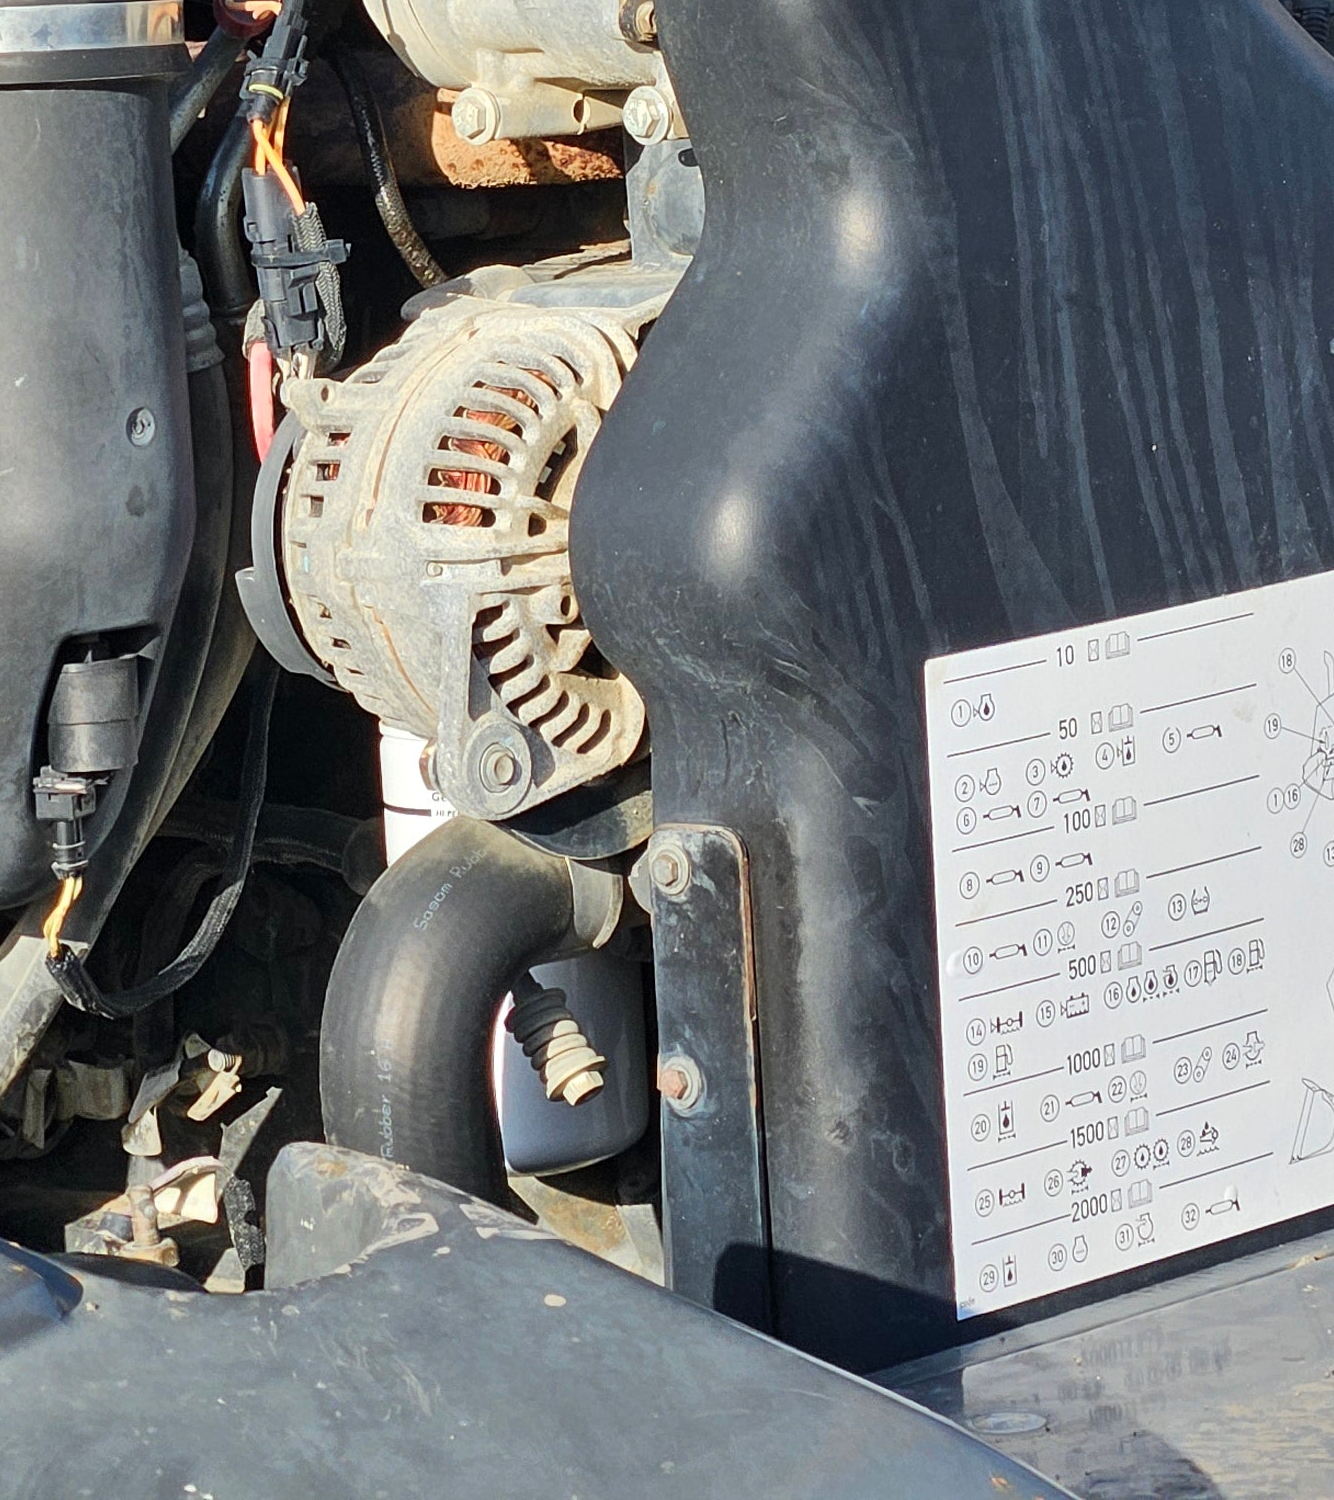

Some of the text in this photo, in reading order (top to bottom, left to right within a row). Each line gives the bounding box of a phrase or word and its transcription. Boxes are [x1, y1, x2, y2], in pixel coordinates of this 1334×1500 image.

[1057, 645, 1074, 667] 10
[1281, 653, 1293, 669] 18
[1059, 718, 1077, 739] 50
[1267, 717, 1279, 733] 19
[1287, 787, 1299, 804] 16
[1064, 809, 1090, 833] 100
[1292, 836, 1305, 853] 28
[1066, 882, 1093, 907] 250
[1171, 899, 1184, 914] 13
[1105, 916, 1117, 932] 12
[1037, 934, 1048, 950] 11
[967, 951, 980, 968] 10
[1068, 955, 1096, 980] 500
[1231, 953, 1243, 969] 18
[1187, 965, 1199, 981] 17
[1108, 987, 1120, 1002] 16
[1040, 1004, 1052, 1021] 15
[970, 1024, 983, 1039] 14
[1067, 1048, 1101, 1075] 1000
[1225, 1048, 1238, 1064] 24
[972, 1058, 985, 1074] 19
[1177, 1062, 1189, 1078] 23
[1111, 1081, 1124, 1097] 22
[1043, 1100, 1055, 1116] 21
[380, 1094, 394, 1159] Rubber
[974, 1119, 988, 1136] 20
[1071, 1121, 1104, 1149] 1500
[1180, 1135, 1193, 1152] 28
[1114, 1154, 1127, 1171] 27
[1047, 1174, 1060, 1191] 26
[978, 1194, 991, 1211] 25
[1071, 1193, 1107, 1222] 2000
[1184, 1208, 1197, 1224] 32
[1119, 1228, 1130, 1245] 31
[1051, 1249, 1064, 1265] 30
[982, 1269, 996, 1287] 29
